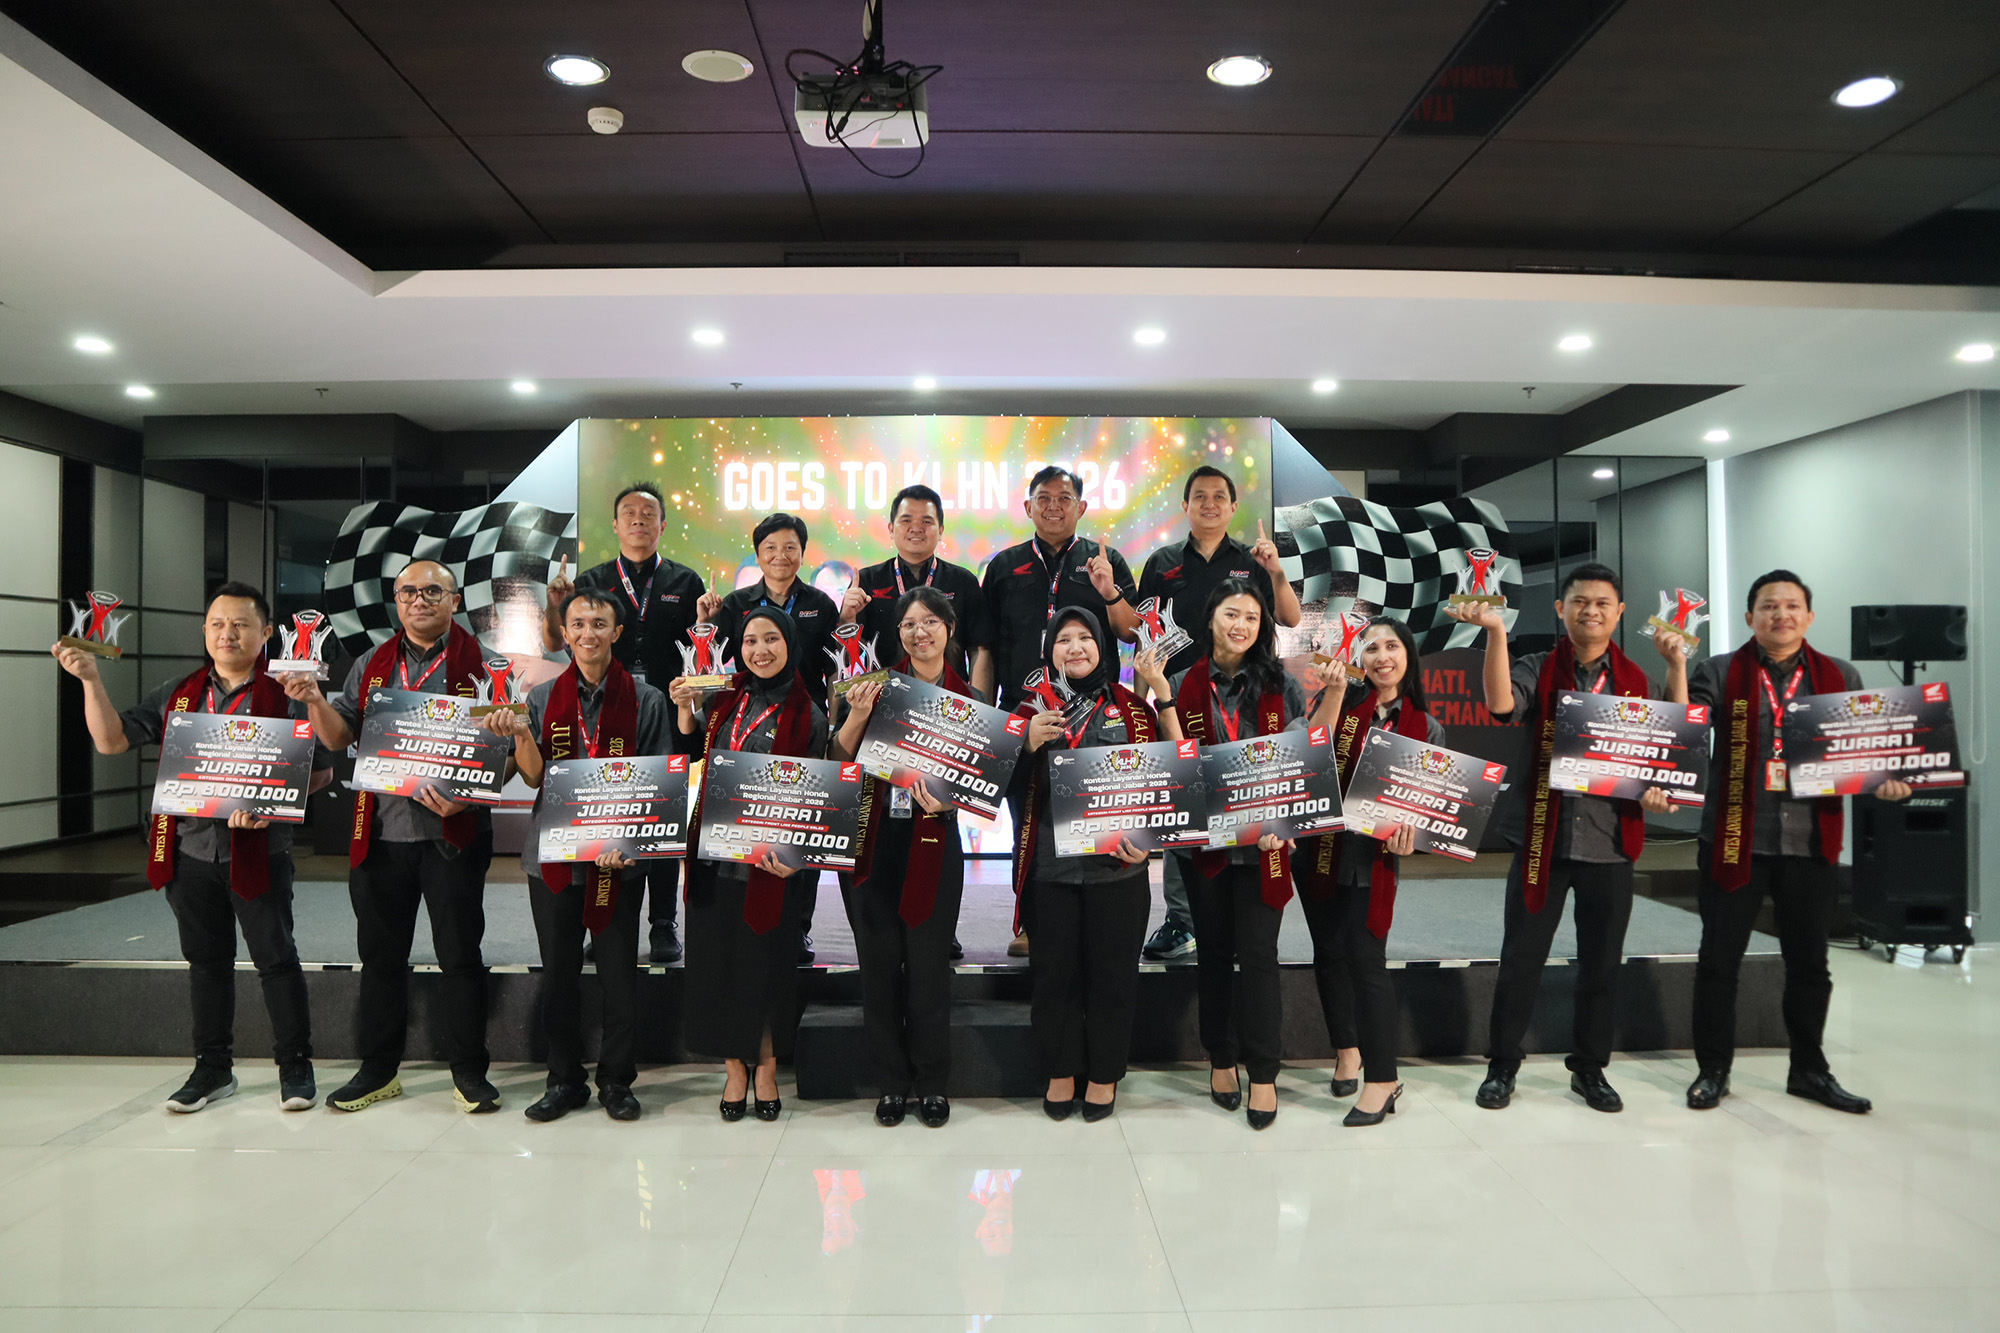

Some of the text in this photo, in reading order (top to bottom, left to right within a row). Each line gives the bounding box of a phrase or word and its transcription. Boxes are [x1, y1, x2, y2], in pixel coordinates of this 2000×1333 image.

[724, 461, 825, 511] GOES
[841, 461, 887, 511] TO
[394, 719, 480, 735] Kontes Layanan Honda
[907, 709, 934, 723] Kontes
[934, 719, 965, 736] Layanan
[966, 730, 991, 744] Honda
[1127, 701, 1149, 744] JUAR
[396, 727, 429, 738] Regional
[429, 731, 453, 740] Jabar
[550, 721, 571, 760] JUA
[908, 717, 984, 750] Regional Jabar 2026
[1827, 732, 1913, 752] JUARA 1
[196, 750, 229, 759] Regional
[230, 752, 254, 760] Jabar
[223, 744, 255, 753] Layanan
[393, 737, 475, 759] JUARA 2
[903, 728, 980, 765] JUARA 1
[1589, 739, 1669, 760] JUARA 1
[193, 760, 273, 777] JUARA 1
[361, 756, 495, 786] Rp. 4.000.000
[868, 739, 999, 798] Rp. 3.500.000
[1221, 759, 1304, 779] Kontes Layanan Honda
[1558, 756, 1697, 786] Rp. 3.500.000
[1799, 751, 1950, 778] Rp. 3.500.000
[1083, 771, 1170, 784] Kontes Layanan Honda
[1086, 783, 1119, 793] Regional
[1121, 781, 1145, 789] Jabar
[1225, 768, 1301, 788] Regional Jabar 2026
[161, 779, 299, 802] Rp. 8.000.000
[576, 794, 608, 802] Regional
[739, 783, 828, 798] Kontes Layanan Honda
[742, 792, 824, 806] Regional Jabar 2026
[1087, 789, 1170, 809] JUARA 3
[1227, 777, 1305, 803] JUARA 2
[1382, 783, 1461, 815] JUARA 3
[576, 802, 652, 817] JUARA 1
[741, 802, 822, 823] JUARA 1
[1209, 796, 1330, 830] Rp. 1.500.000
[1356, 799, 1468, 841] Rp. 500.000
[547, 822, 679, 843] Rp. 3.500.000
[1069, 810, 1189, 836] Rp. 500.000
[709, 823, 849, 850] Rp. 3.500.000
